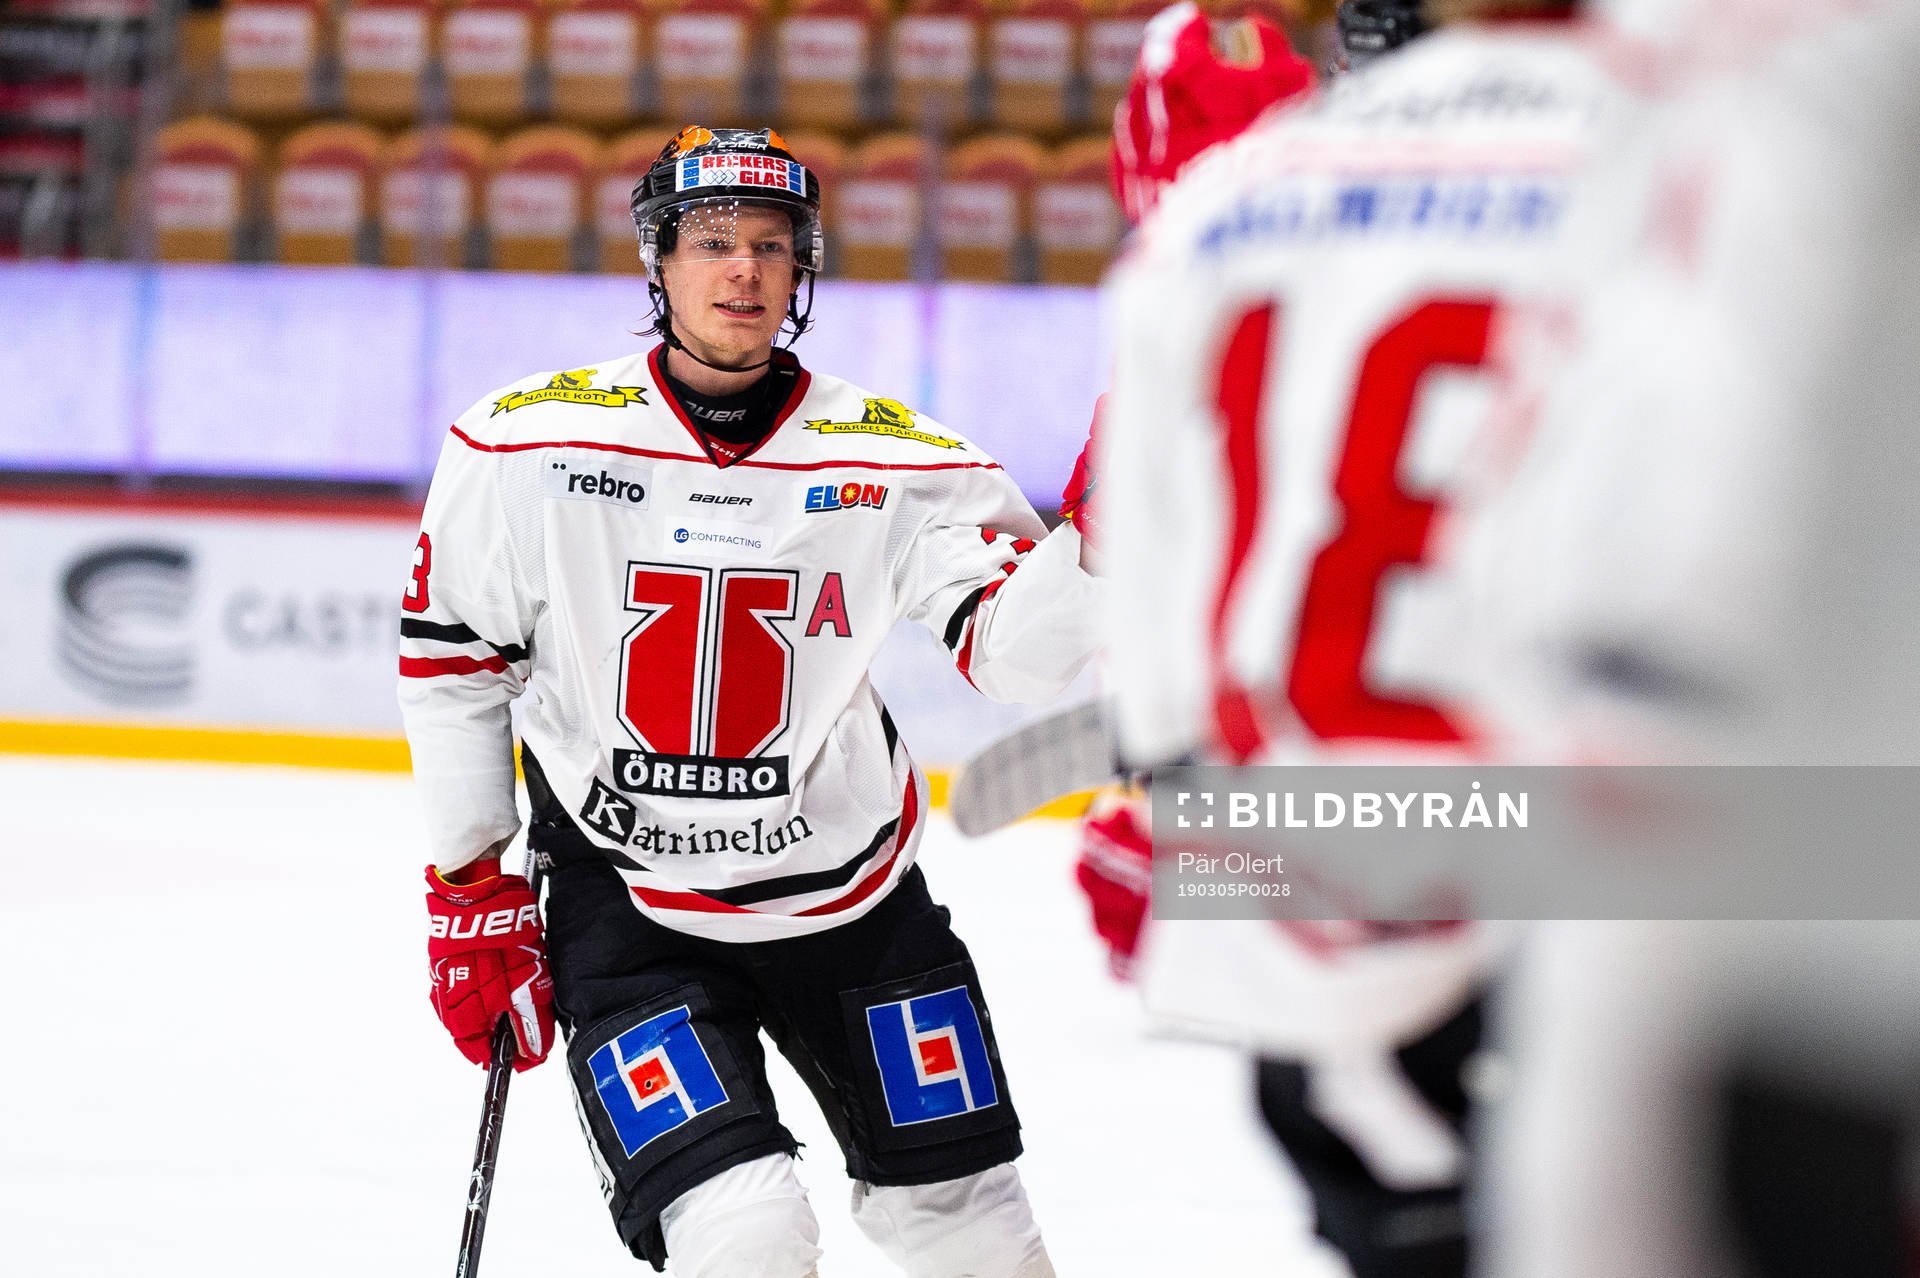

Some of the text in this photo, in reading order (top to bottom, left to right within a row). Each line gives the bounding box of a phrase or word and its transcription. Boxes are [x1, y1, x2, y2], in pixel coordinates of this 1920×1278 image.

[702, 155, 786, 173] BECKERS
[739, 170, 787, 188] GLAS
[686, 400, 747, 422] UER
[688, 492, 753, 506] BAUER
[804, 482, 888, 513] ELON
[673, 529, 762, 549] LG CONTRACTING
[805, 572, 852, 637] A
[222, 585, 401, 657] CAST
[623, 753, 777, 792] ÖREBRO
[430, 903, 539, 940] AUER
